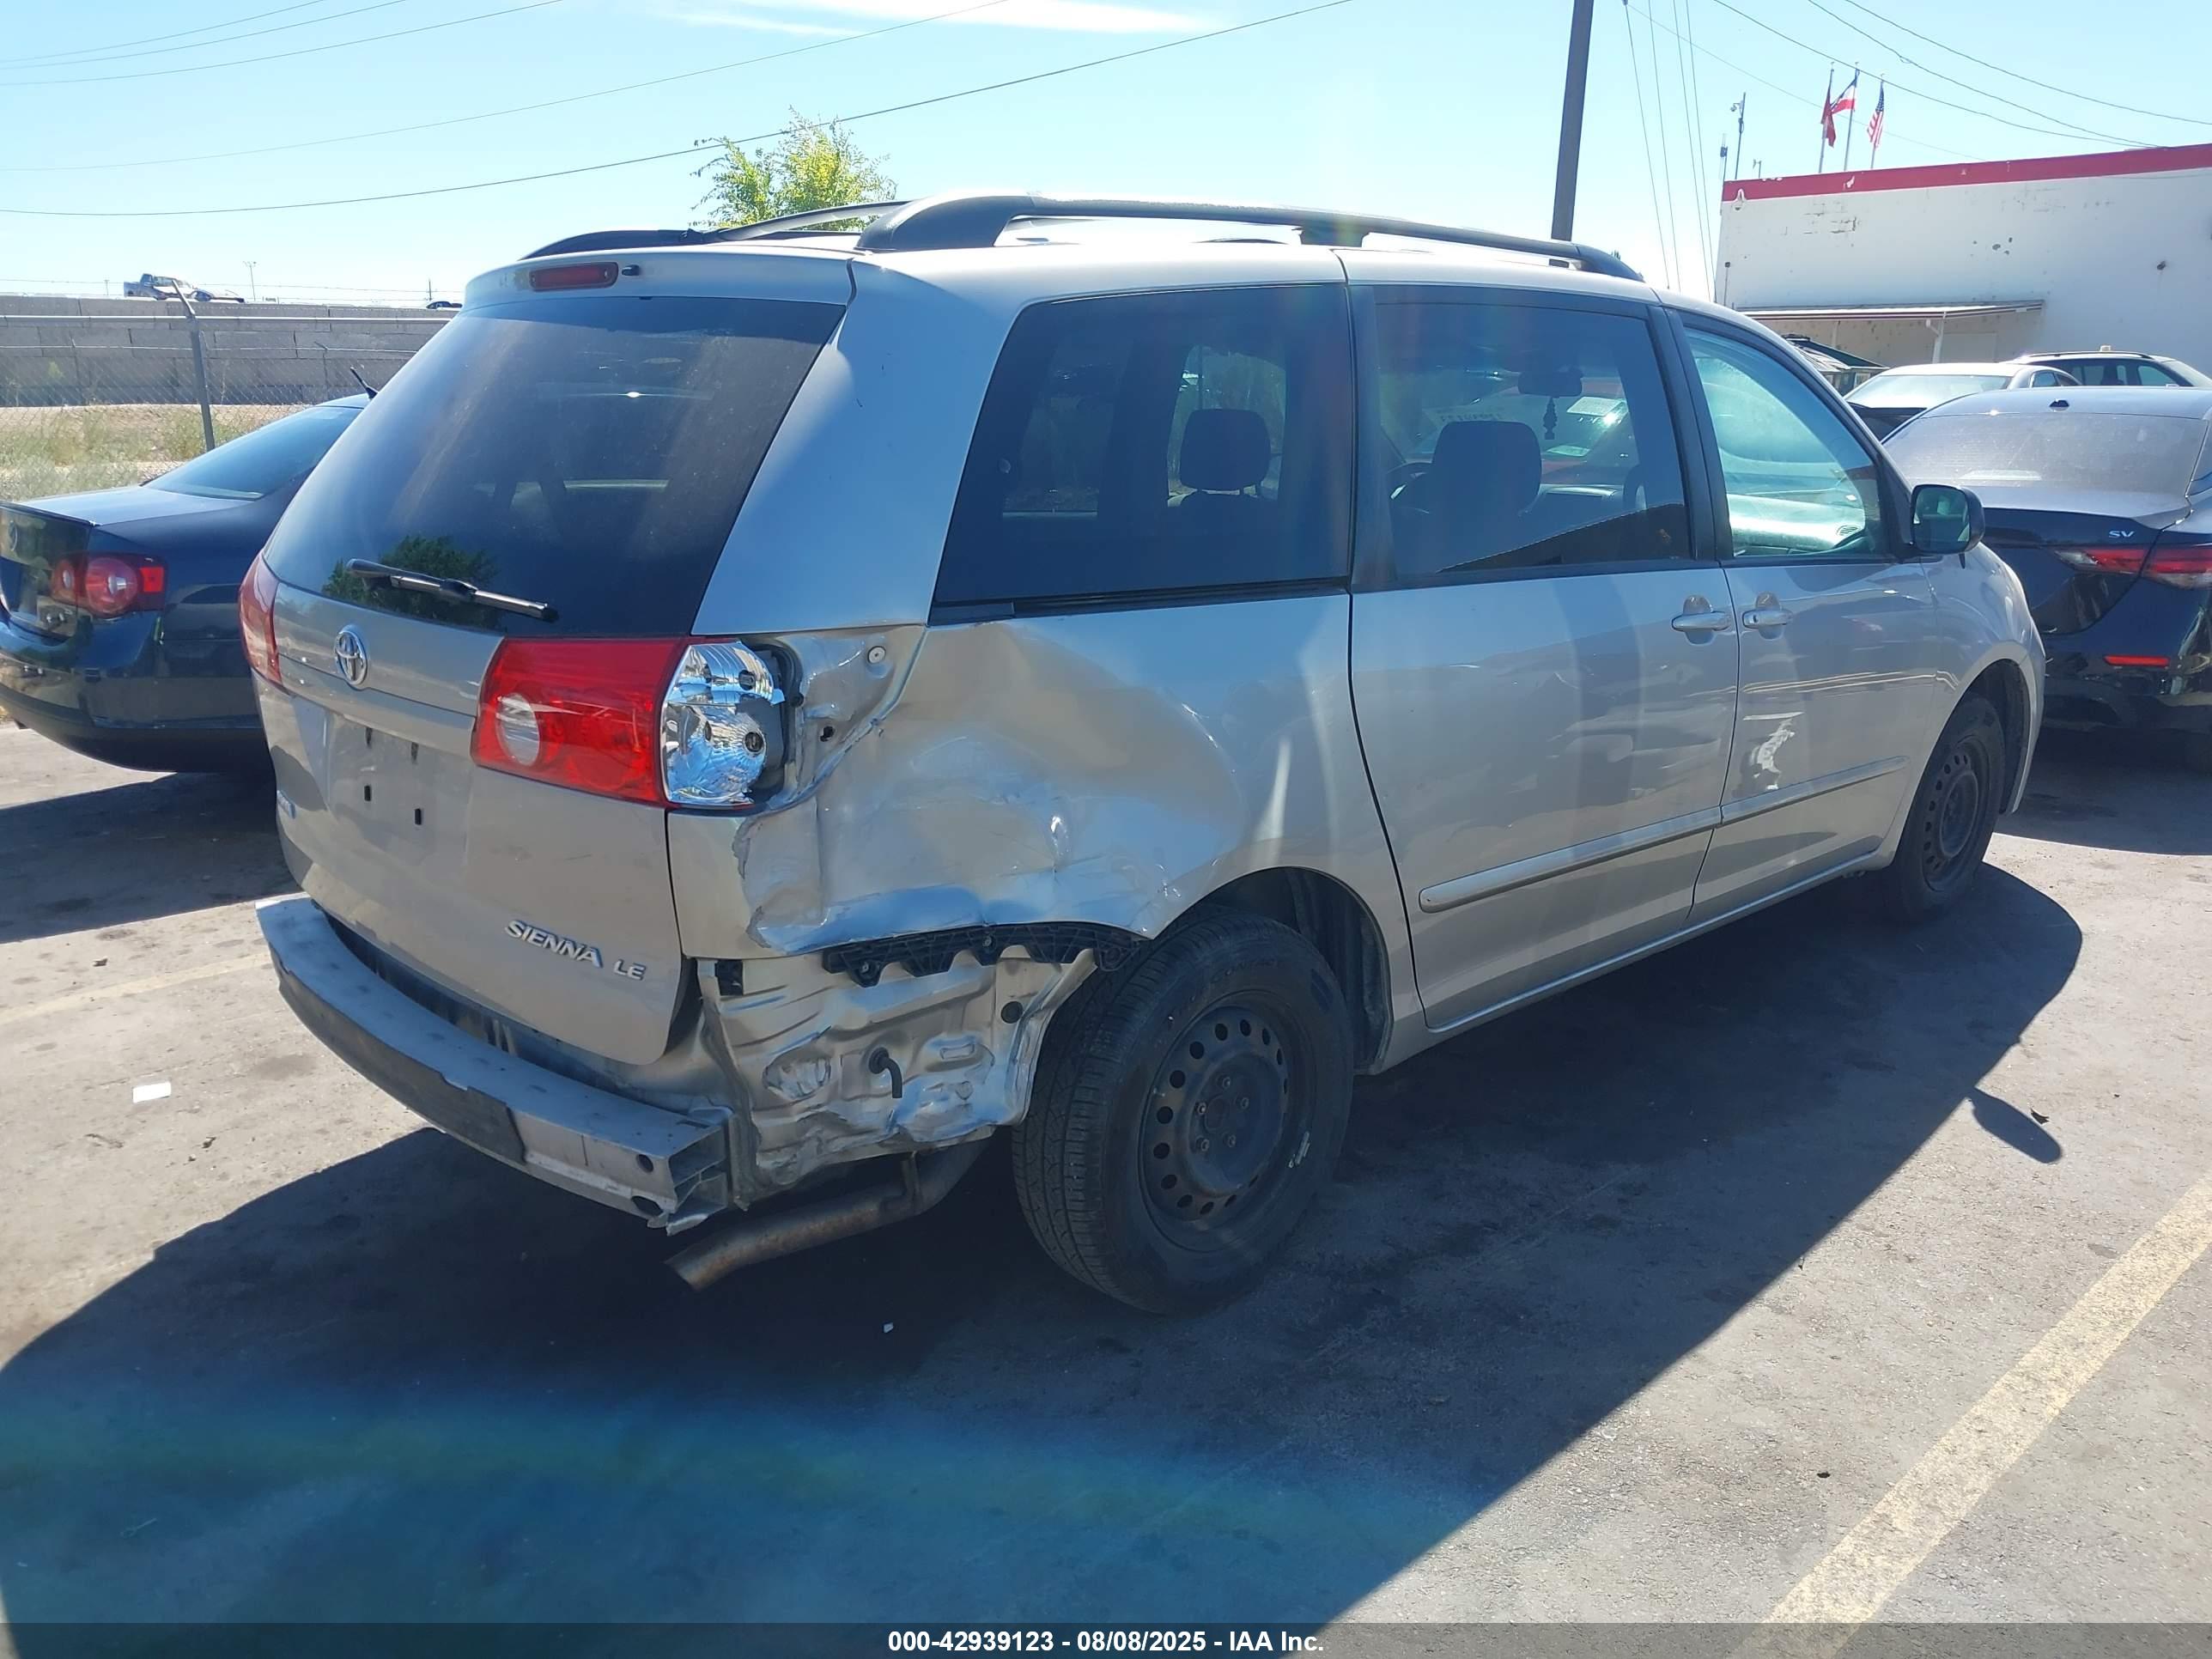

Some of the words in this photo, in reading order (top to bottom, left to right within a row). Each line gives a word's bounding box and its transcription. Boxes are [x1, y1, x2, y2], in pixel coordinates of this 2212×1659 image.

[2108, 530, 2135, 538] SV
[505, 920, 603, 969] SIENNA
[613, 959, 647, 981] LE
